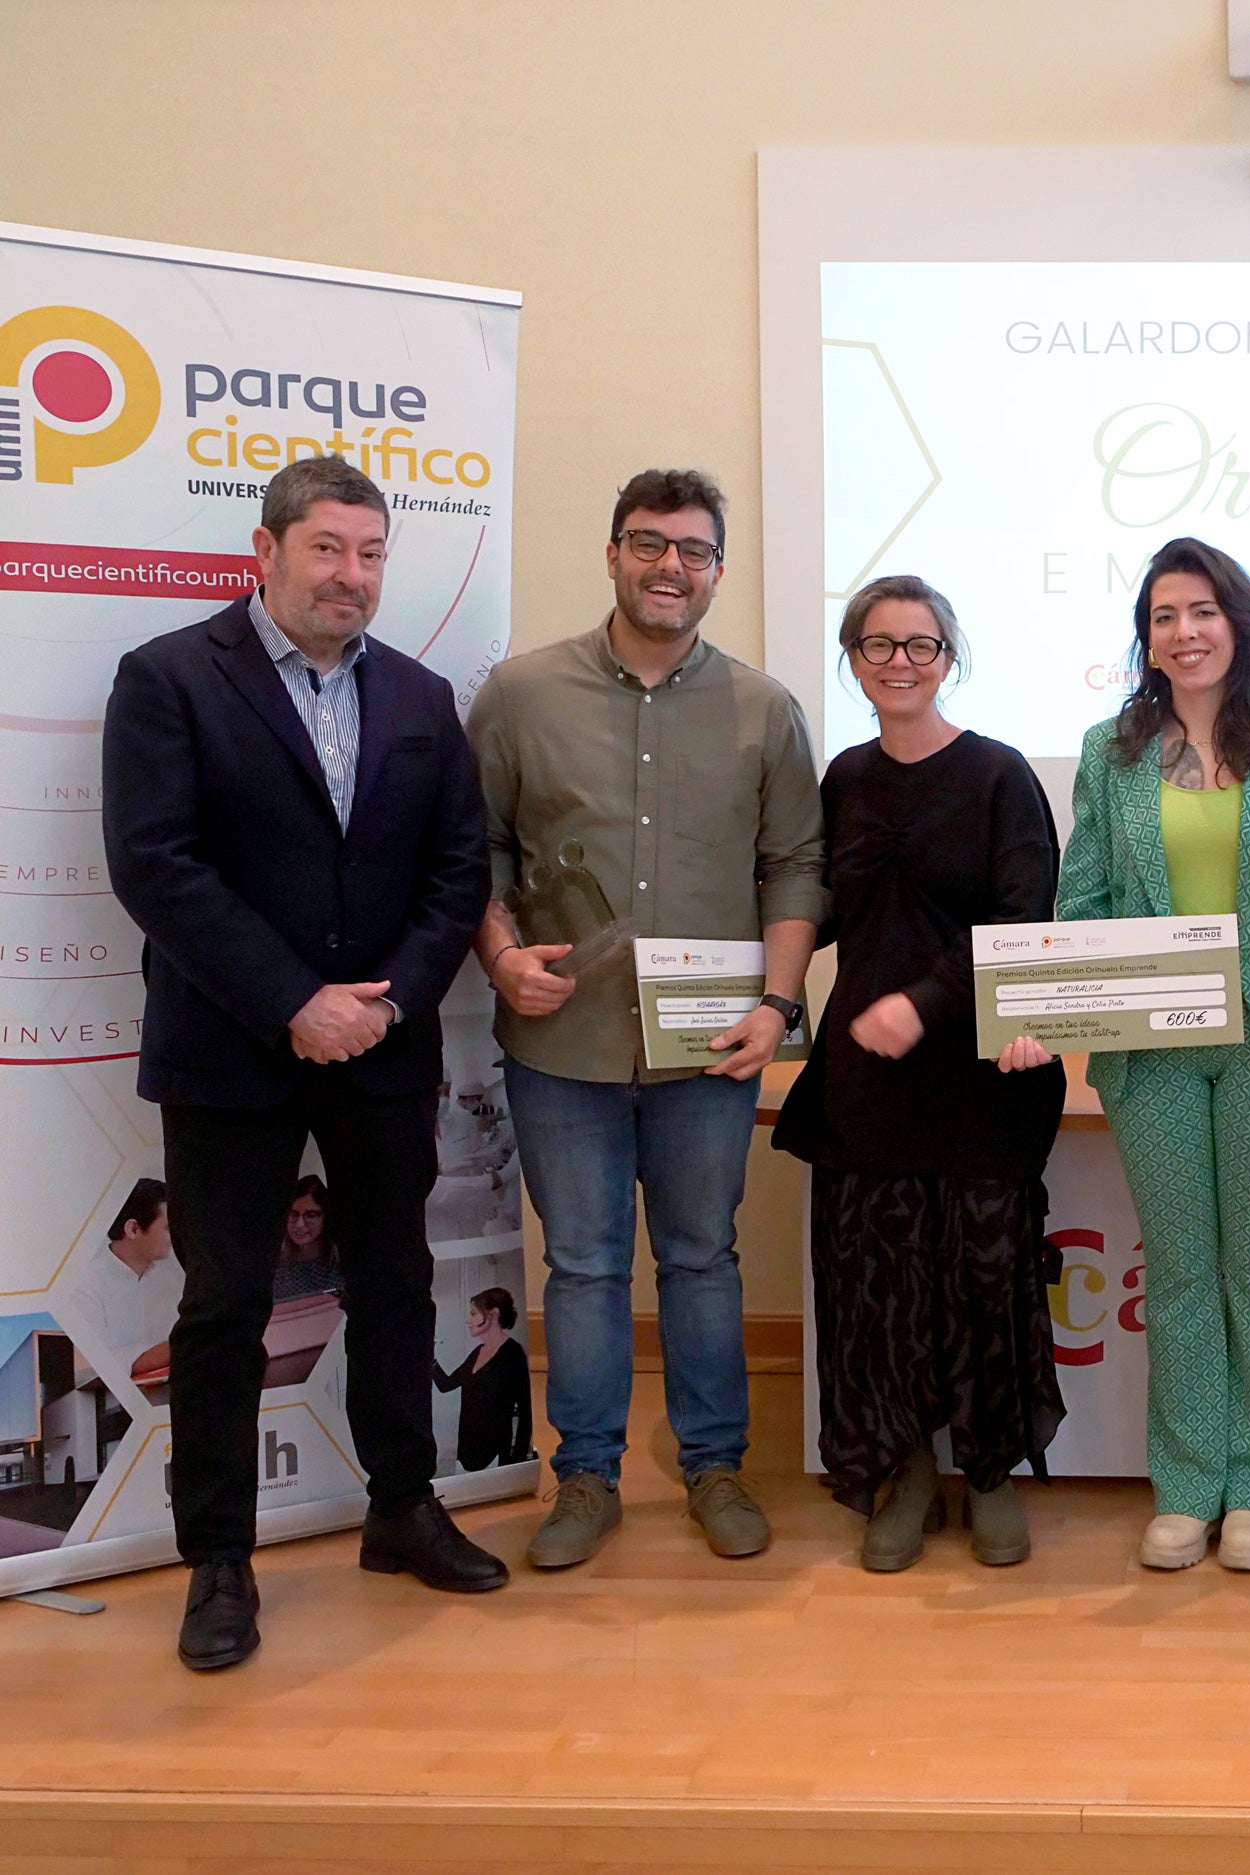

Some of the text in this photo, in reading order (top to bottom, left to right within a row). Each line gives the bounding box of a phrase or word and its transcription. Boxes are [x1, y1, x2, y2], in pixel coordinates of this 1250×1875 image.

[185, 363, 426, 429] parque
[392, 493, 492, 517] Hernández
[0, 561, 257, 588] arquecientificoumh
[992, 938, 1030, 951] Cámara
[996, 963, 1158, 979] Premios Quinta Edición Orihuela Emprende
[1166, 1011, 1207, 1026] 600€
[257, 1479, 299, 1493] ernández
